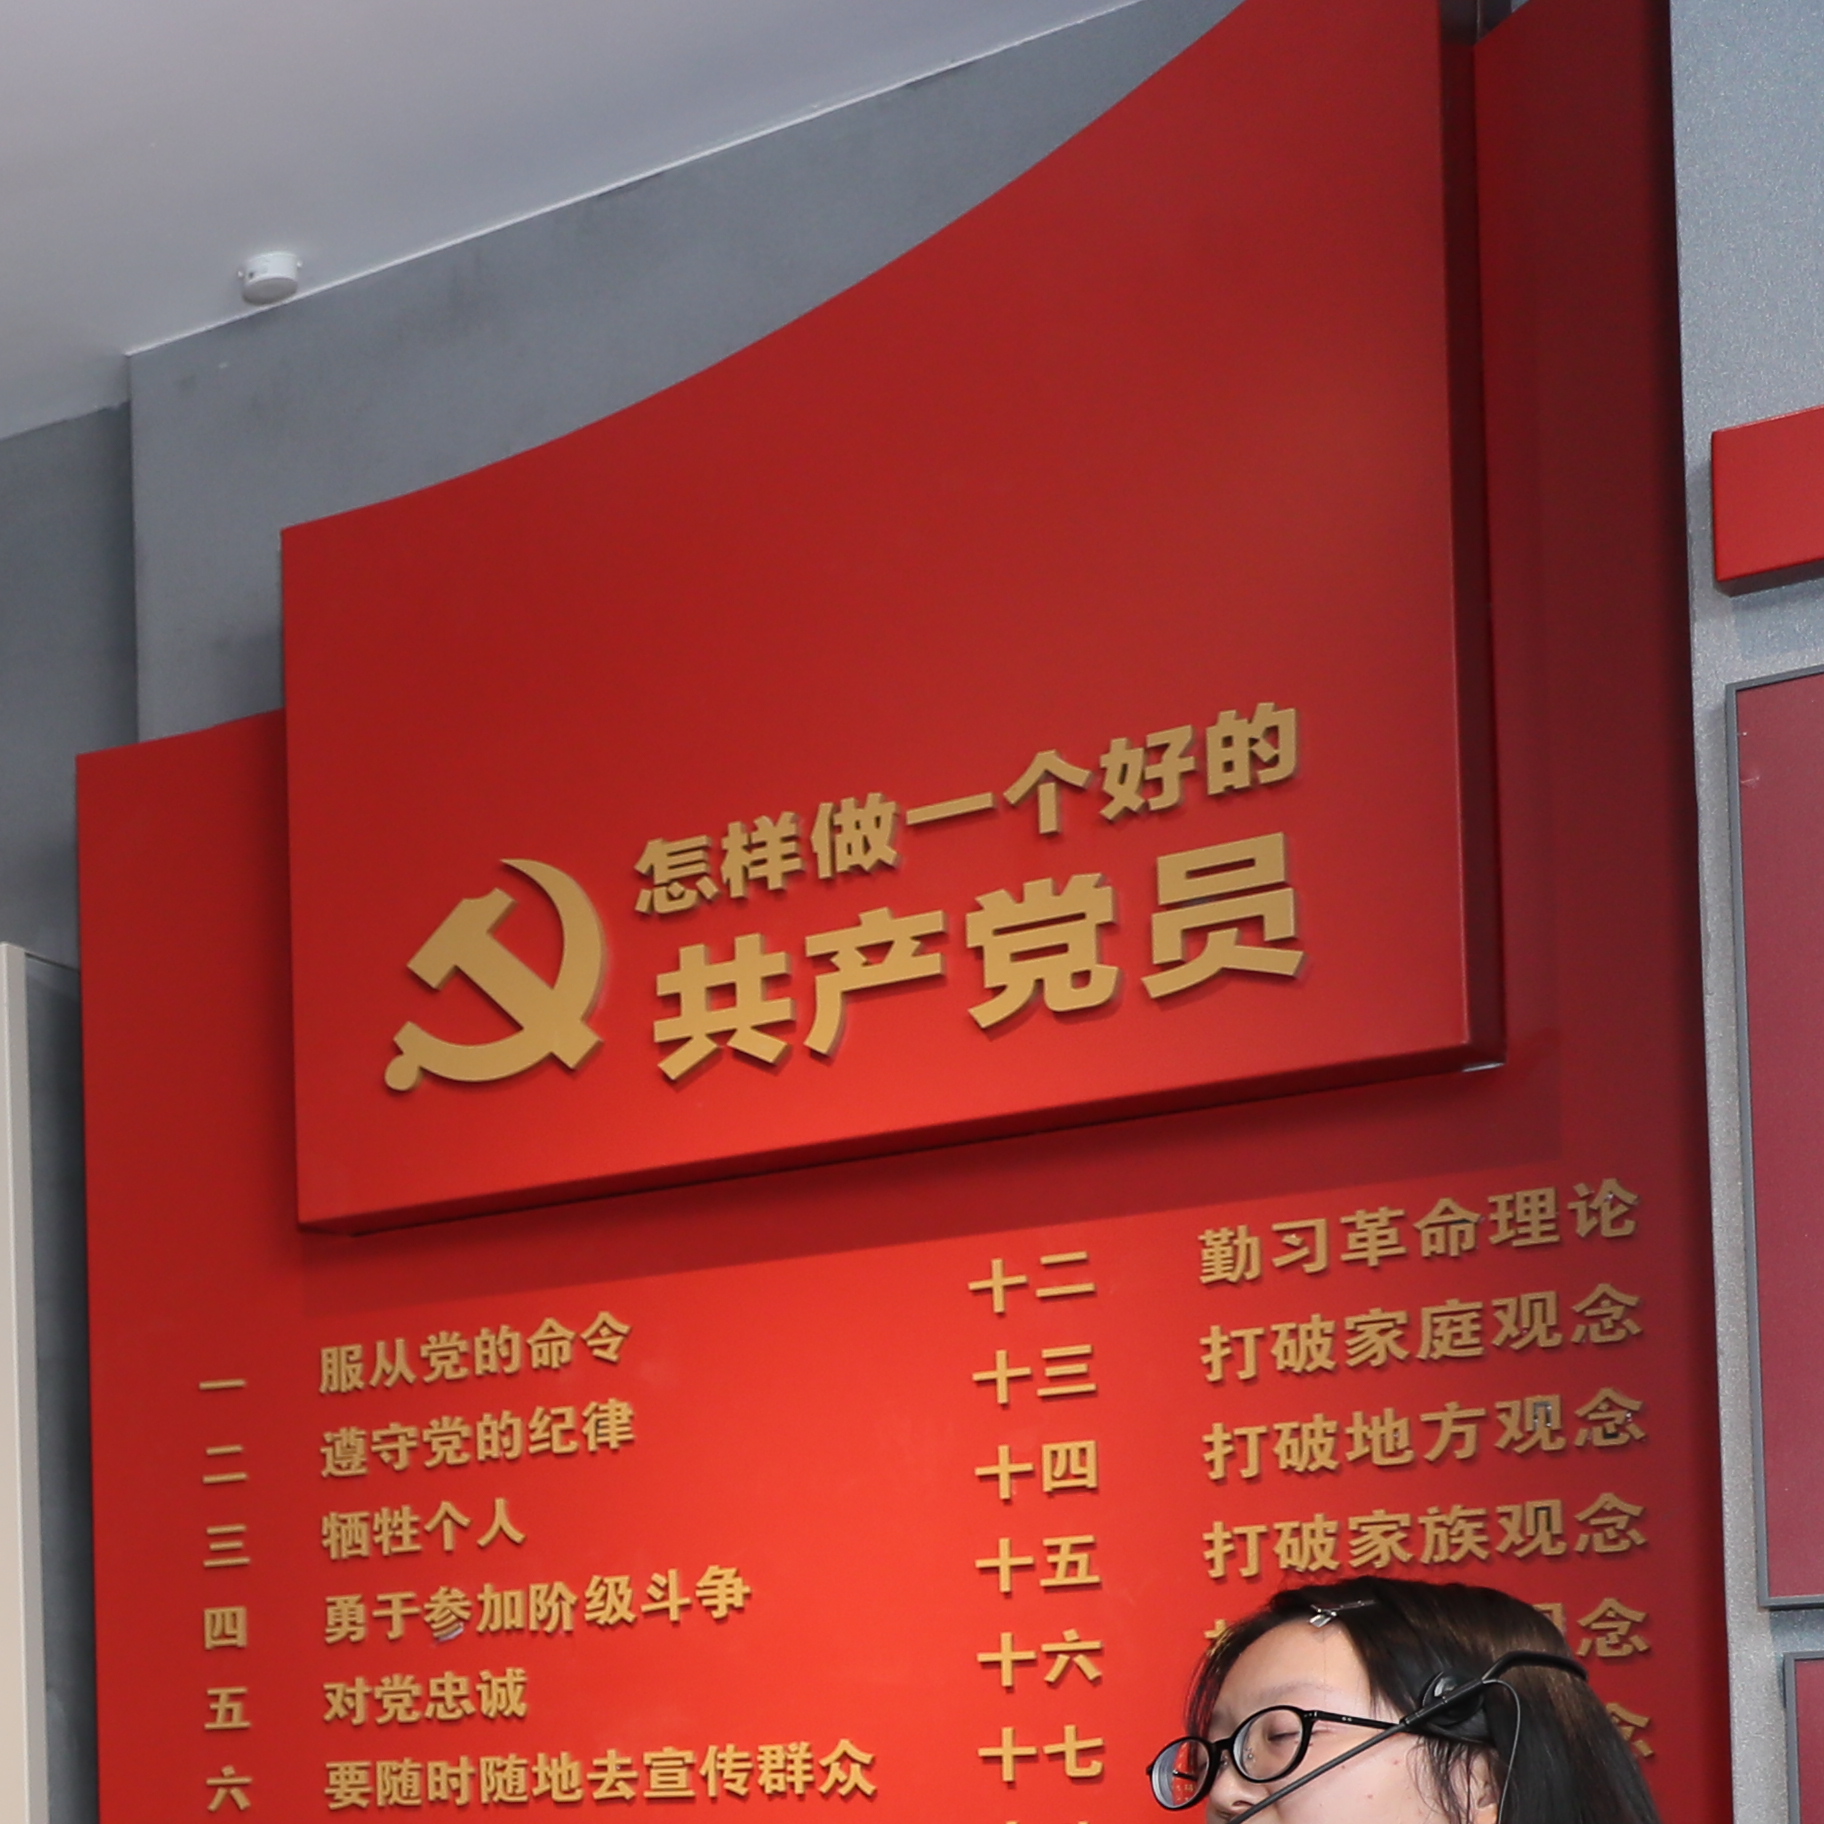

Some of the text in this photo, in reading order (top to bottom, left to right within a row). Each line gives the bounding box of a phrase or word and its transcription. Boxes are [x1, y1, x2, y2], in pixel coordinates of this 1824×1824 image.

[635, 702, 1296, 913] 怎样做一个好的
[654, 832, 1303, 1079] 共产党员
[968, 1179, 1637, 1312] 十二 勤习革命理论
[200, 1311, 630, 1392] 一 服从党的命令
[973, 1284, 1640, 1403] 十三 打破家庭观念
[203, 1398, 636, 1483] 二 遵守党的纪律
[975, 1389, 1644, 1499] 十四 打破地方观念
[204, 1498, 525, 1566] 三 牺牲个人
[976, 1493, 1644, 1592] 十五 打破家族观念
[204, 1565, 752, 1649] 四 勇于参加阶级斗争
[205, 1667, 528, 1729] 五 对党忠诚
[977, 1629, 1101, 1686] 十六
[207, 1739, 876, 1810] 六 要随时随地去宣传群众
[978, 1725, 1103, 1781] 十七
